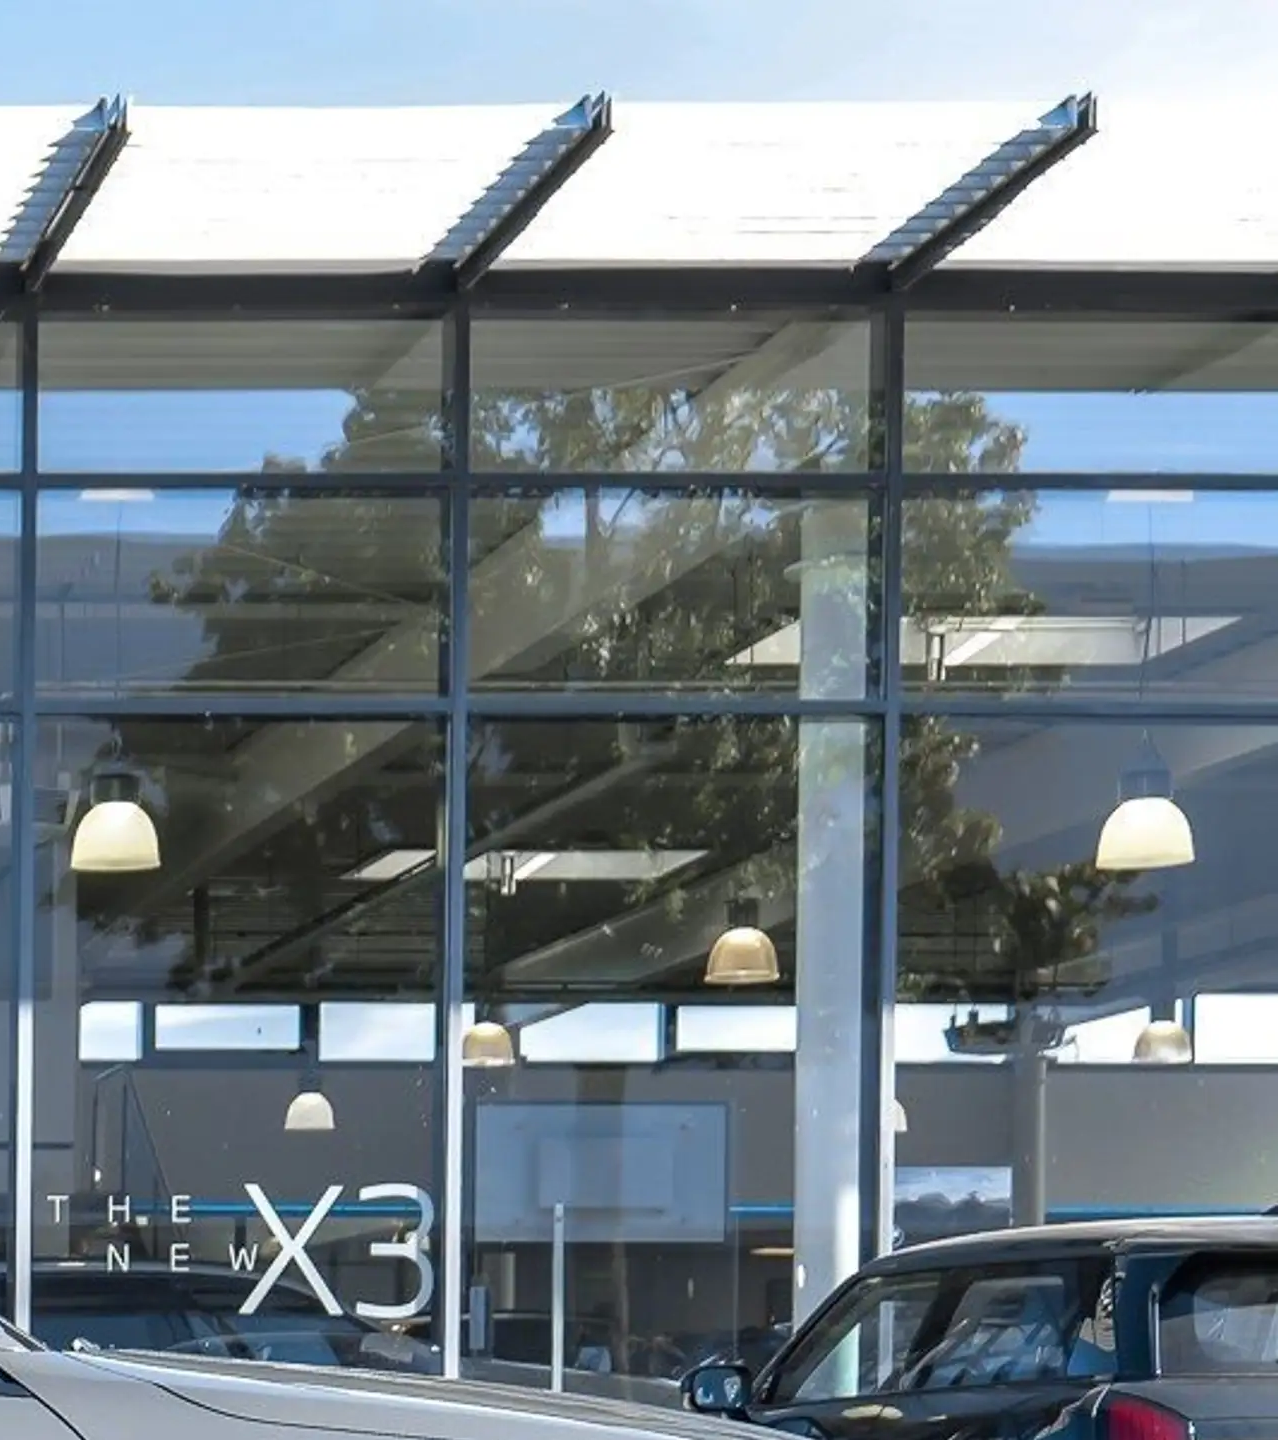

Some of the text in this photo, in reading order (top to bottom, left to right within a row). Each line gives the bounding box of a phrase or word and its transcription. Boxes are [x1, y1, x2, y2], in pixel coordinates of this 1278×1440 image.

[46, 1195, 191, 1224] THE
[106, 1243, 259, 1272] NEW
[238, 1182, 435, 1319] X3
